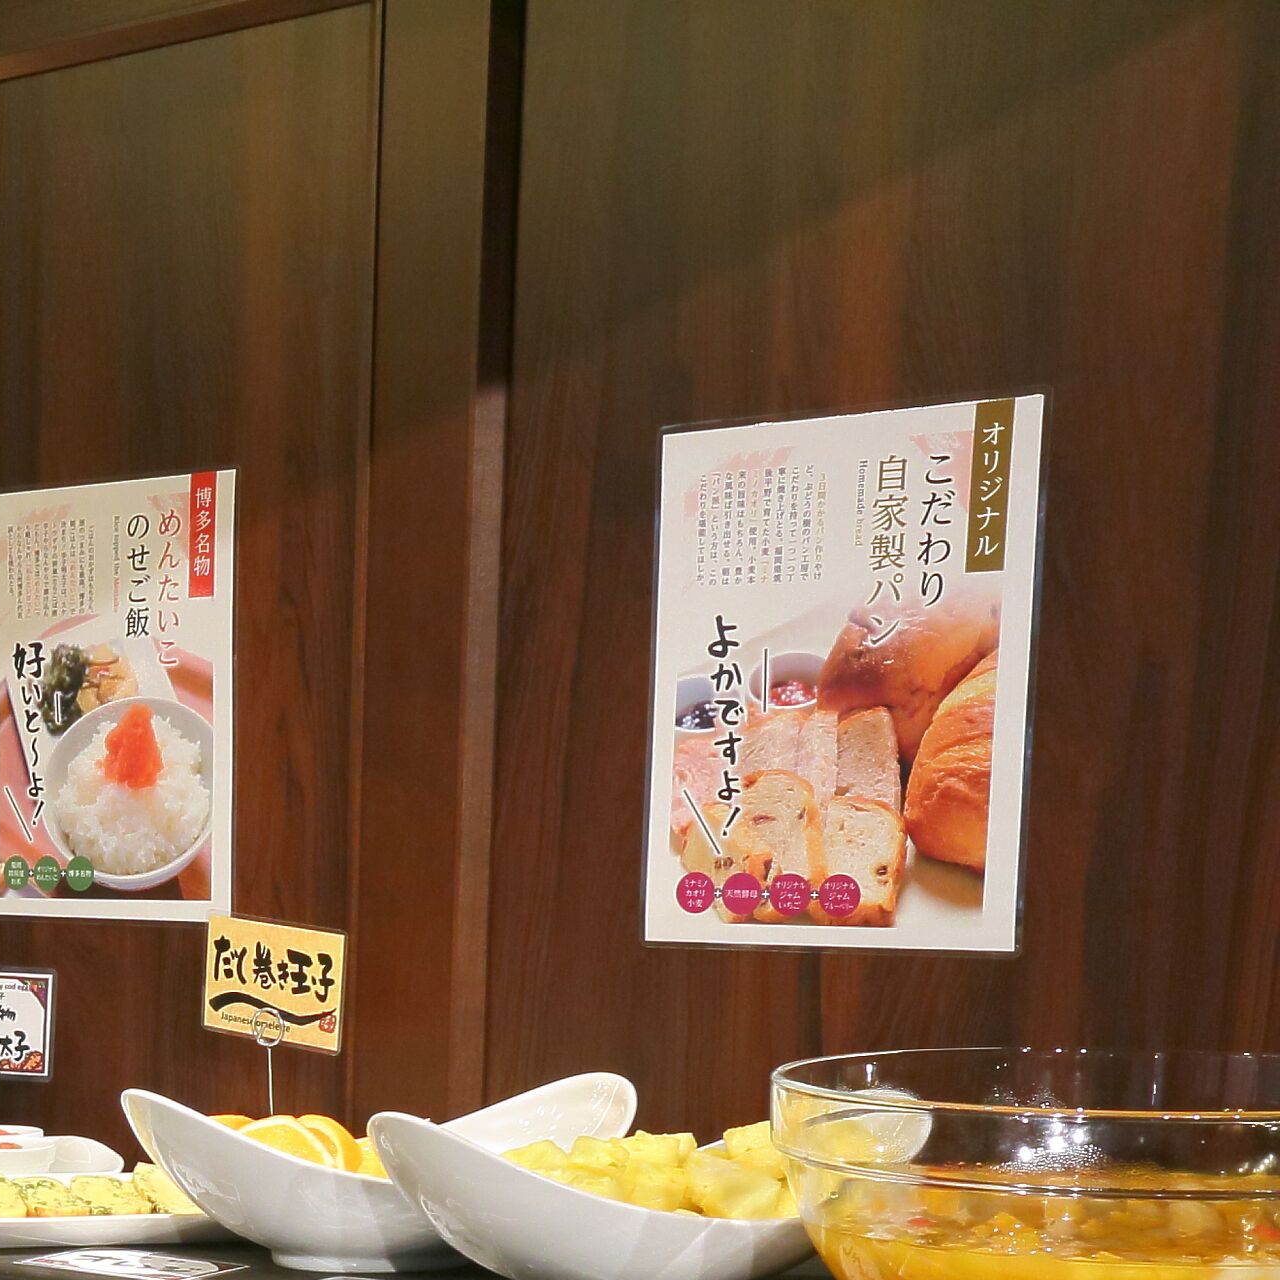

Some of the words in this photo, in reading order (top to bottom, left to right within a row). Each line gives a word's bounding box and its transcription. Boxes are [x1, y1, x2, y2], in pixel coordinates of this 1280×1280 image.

[856, 460, 868, 516] Homemade
[974, 421, 1005, 557] オリジナル
[194, 487, 211, 576] 博多名物
[855, 518, 864, 547] bread
[867, 455, 909, 645] 自家製パン
[917, 455, 955, 607] こだわり
[125, 512, 151, 638] のせご飯
[157, 510, 181, 666] めんたいこ
[13, 641, 46, 826] 好いと〜よ！
[706, 614, 745, 838] よかですよ！
[684, 879, 708, 888] ミナミノ
[685, 889, 706, 898] カオリ
[687, 899, 703, 908] 小麦
[725, 889, 759, 899] 天然酵母
[775, 881, 806, 890] オリジナル
[779, 891, 801, 900] ジャム
[824, 881, 856, 890] オリジナル
[829, 892, 851, 901] ジャム
[778, 901, 801, 911] いちご
[214, 935, 335, 1003] だし巻き玉子
